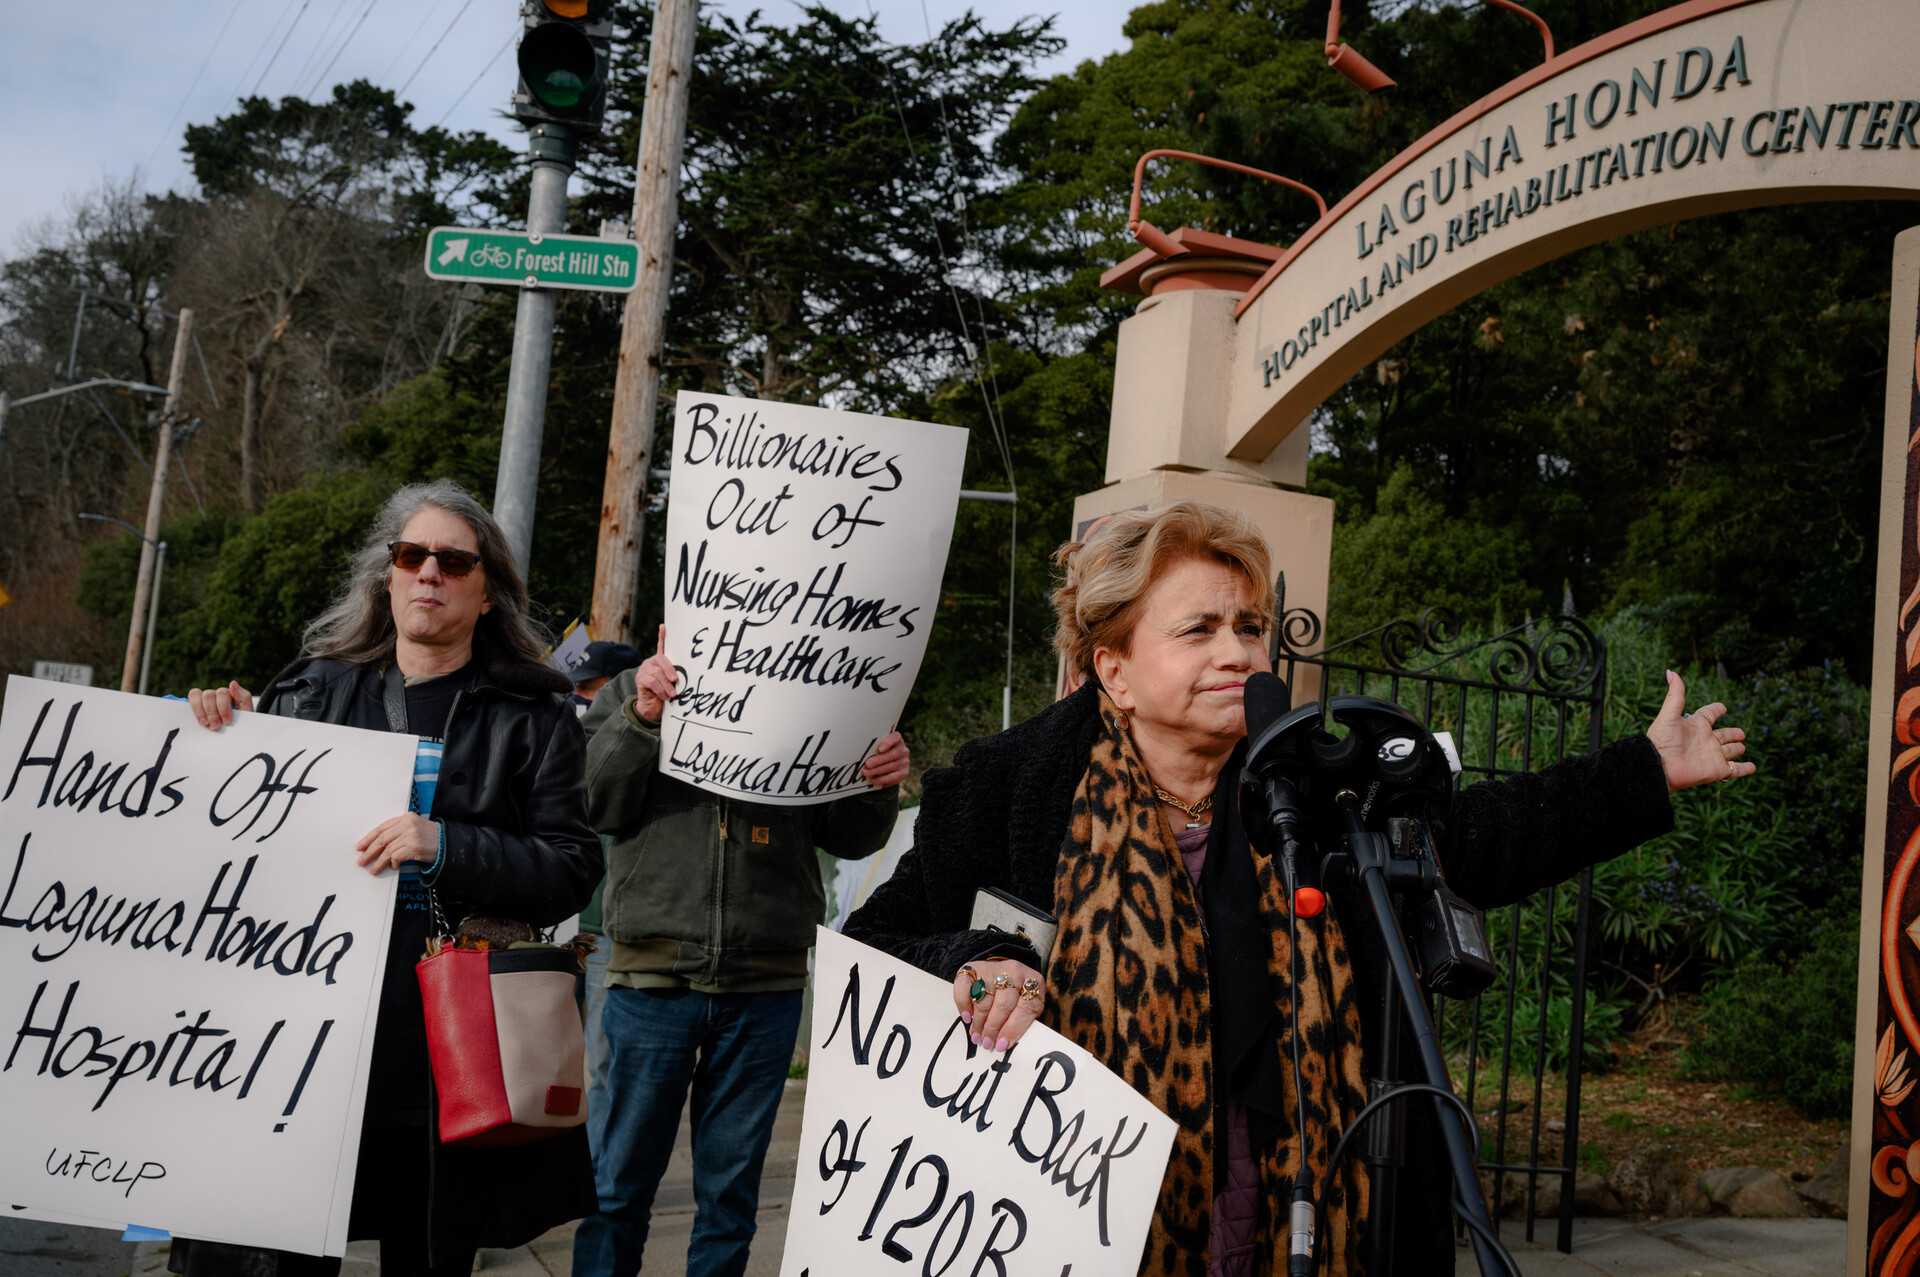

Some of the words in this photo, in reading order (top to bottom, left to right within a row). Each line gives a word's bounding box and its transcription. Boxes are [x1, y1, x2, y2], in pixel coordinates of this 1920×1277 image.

[1355, 125, 1522, 260] LAGUNA
[1544, 35, 1751, 148] HONDA
[515, 248, 565, 273] Forest
[568, 252, 599, 275] Hill
[602, 254, 630, 278] Stn
[1262, 276, 1373, 388] HOSPITAL
[1377, 232, 1439, 298] AND
[1445, 116, 1734, 252] REHABILITATION
[1741, 100, 1920, 156] CENTER
[685, 403, 903, 491] Billionaires
[706, 478, 794, 536] Out
[811, 496, 885, 549] of
[672, 539, 799, 627] Nursing
[792, 562, 920, 638] Homes
[2, 699, 190, 818] Hands
[209, 747, 333, 843] Off
[669, 721, 781, 793] Laguna
[0, 832, 182, 962] Laguna
[181, 854, 354, 985] Honda
[822, 962, 911, 1080] No
[923, 1016, 1020, 1132] Cut
[46, 1147, 167, 1198] UFCLP
